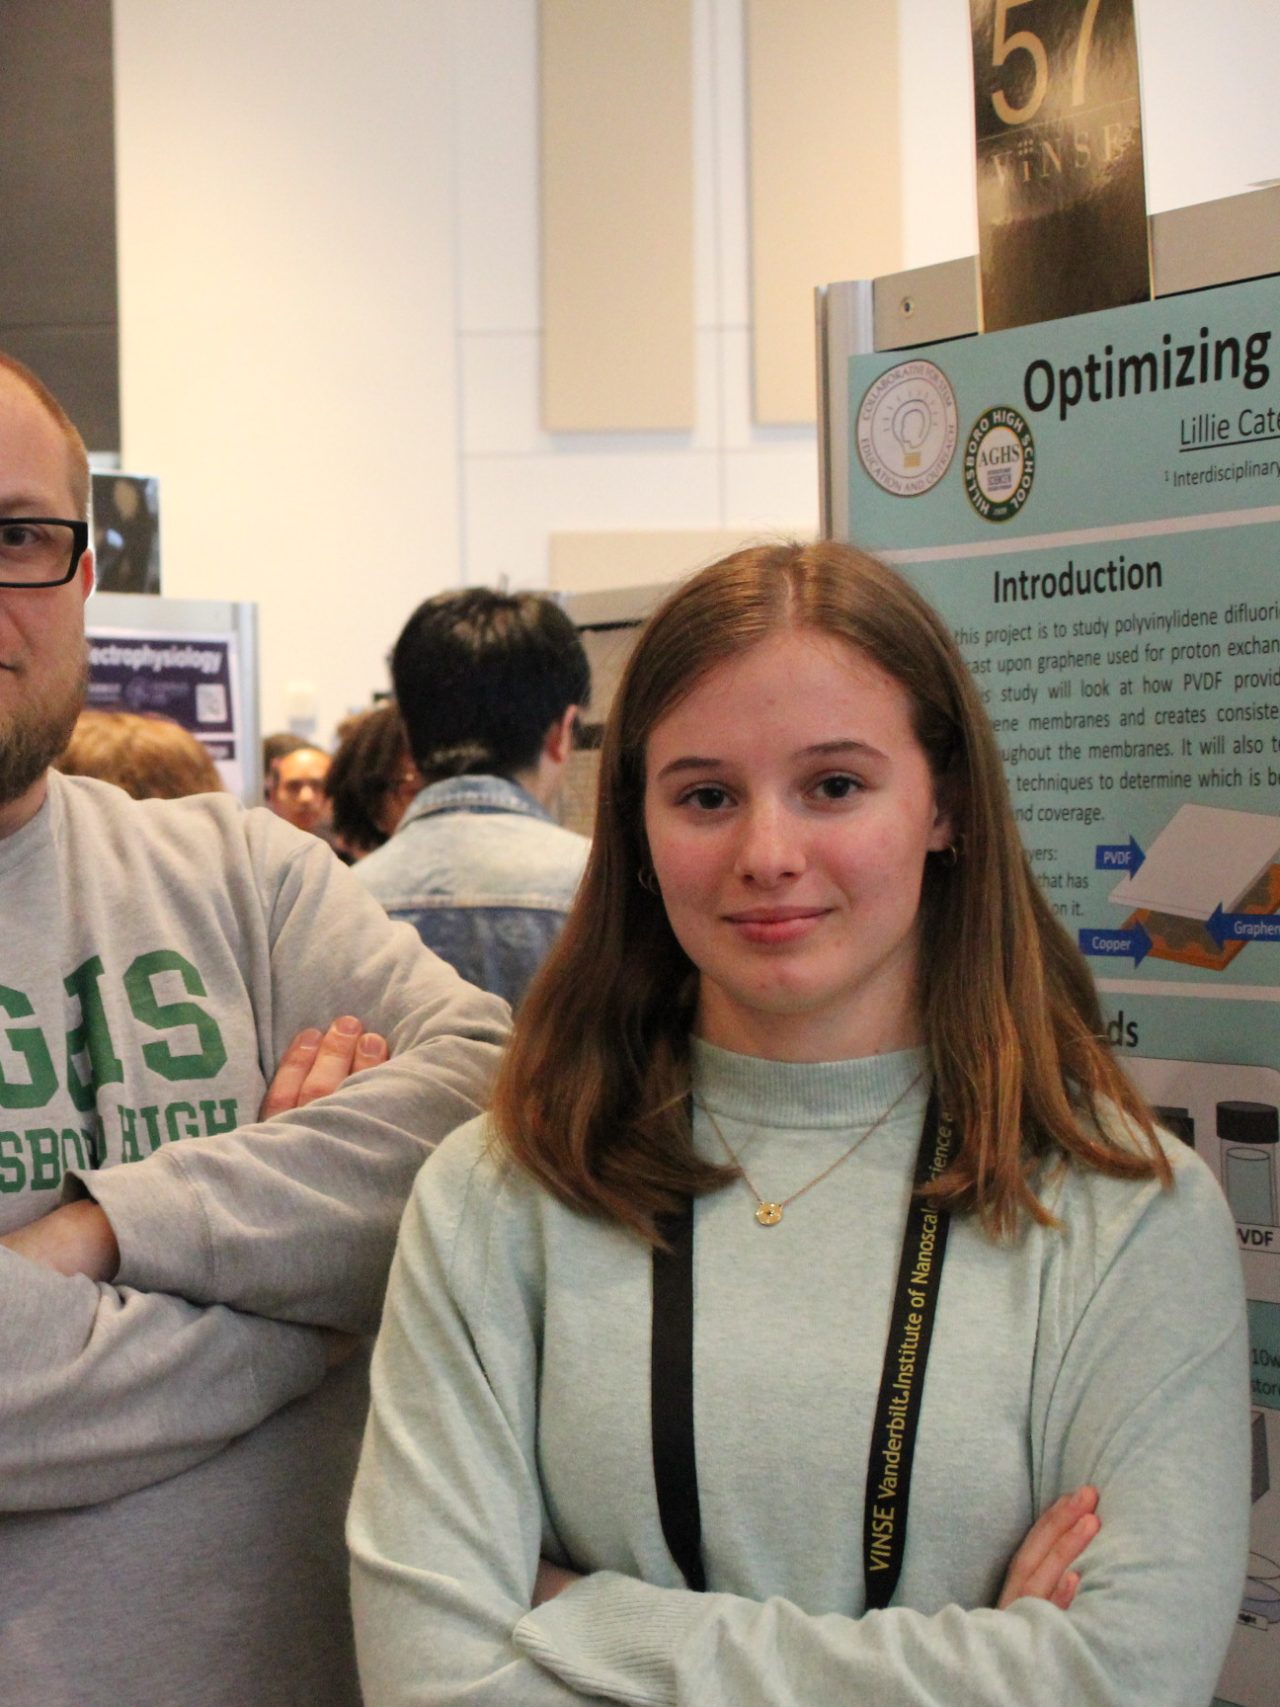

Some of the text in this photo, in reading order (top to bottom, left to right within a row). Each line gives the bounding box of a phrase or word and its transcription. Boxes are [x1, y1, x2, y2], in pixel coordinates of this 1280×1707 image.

[1024, 326, 1272, 420] Optimizing
[1181, 413, 1230, 445] Lillie
[979, 444, 1020, 467] AGHS
[992, 410, 1024, 433] HIGH
[1011, 434, 1034, 509] SCHOOL
[993, 556, 1162, 603] Introduction
[985, 624, 1032, 646] project
[1038, 621, 1048, 639] is
[1054, 622, 1067, 638] to
[1072, 616, 1110, 638] study
[1115, 608, 1218, 637] polyvinylidene
[997, 657, 1032, 675] upon
[1038, 650, 1101, 674] graphene
[1107, 644, 1139, 665] used
[1145, 643, 1165, 663] for
[1171, 641, 1221, 664] proton
[1001, 683, 1038, 704] study
[1048, 680, 1071, 699] will
[1081, 678, 1110, 698] look
[1120, 678, 1133, 695] at
[1143, 675, 1173, 694] how
[1183, 671, 1223, 691] PVDF
[1029, 711, 1110, 730] membranes
[1120, 708, 1145, 726] and
[1154, 707, 1207, 725] creates
[1058, 741, 1081, 760] the
[1088, 740, 1175, 759] membranes.
[1181, 738, 1192, 756] It
[1200, 735, 1225, 755] will
[1233, 735, 1264, 755] also
[1016, 773, 1094, 793] techniques
[1099, 773, 1114, 790] to
[1120, 770, 1192, 790] determine
[1199, 768, 1243, 787] which
[1249, 767, 1261, 786] is
[1037, 807, 1105, 825] coverage.
[1103, 851, 1132, 865] PVDF
[1067, 873, 1089, 889] has
[1092, 936, 1132, 953] Copper
[926, 1126, 952, 1185] ience
[911, 1200, 939, 1284] Nanoscal
[907, 1289, 925, 1308] of
[869, 1504, 895, 1571] VINSE
